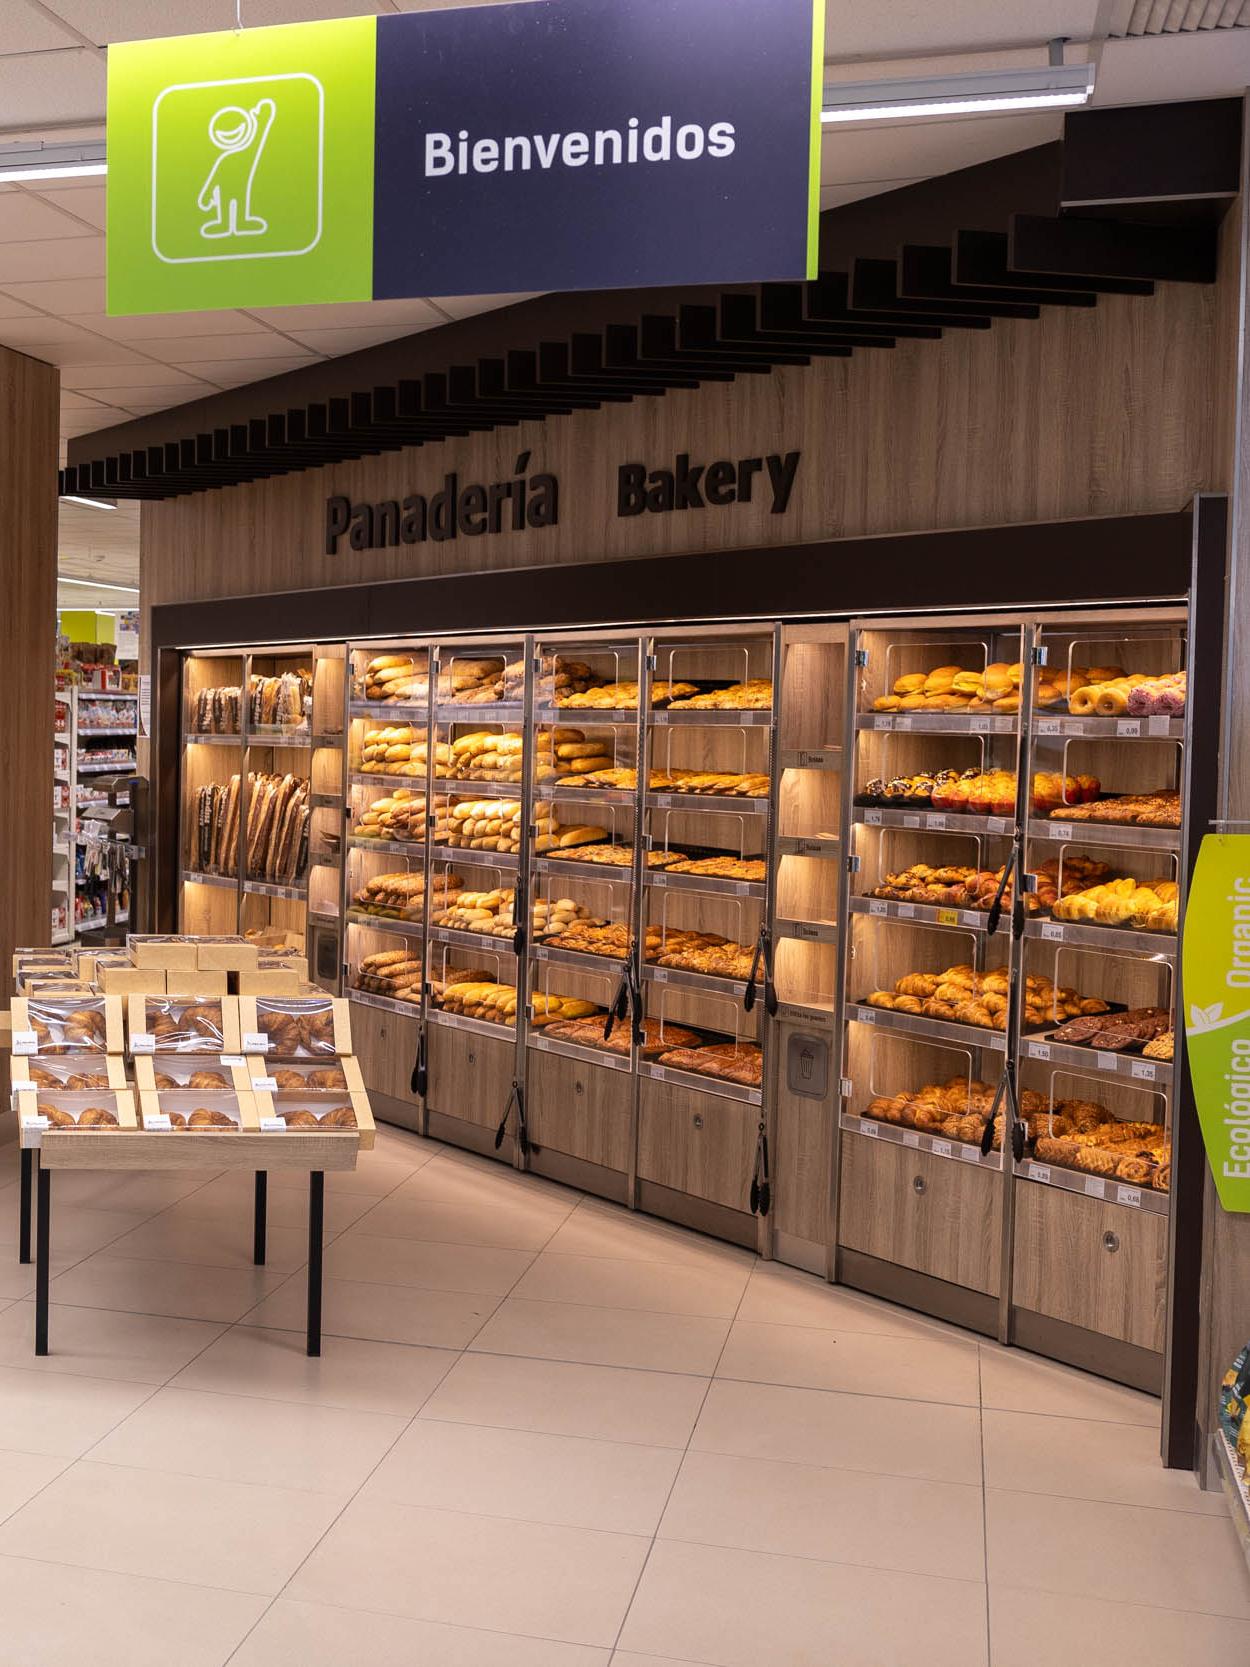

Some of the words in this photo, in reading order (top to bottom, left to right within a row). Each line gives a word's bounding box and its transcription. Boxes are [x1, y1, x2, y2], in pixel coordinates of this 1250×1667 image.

[425, 115, 736, 178] Bienvenidos
[325, 450, 559, 556] Panadería
[617, 450, 801, 517] Bakery
[1225, 877, 1250, 988] Organic
[1223, 1038, 1250, 1178] Ecológico
